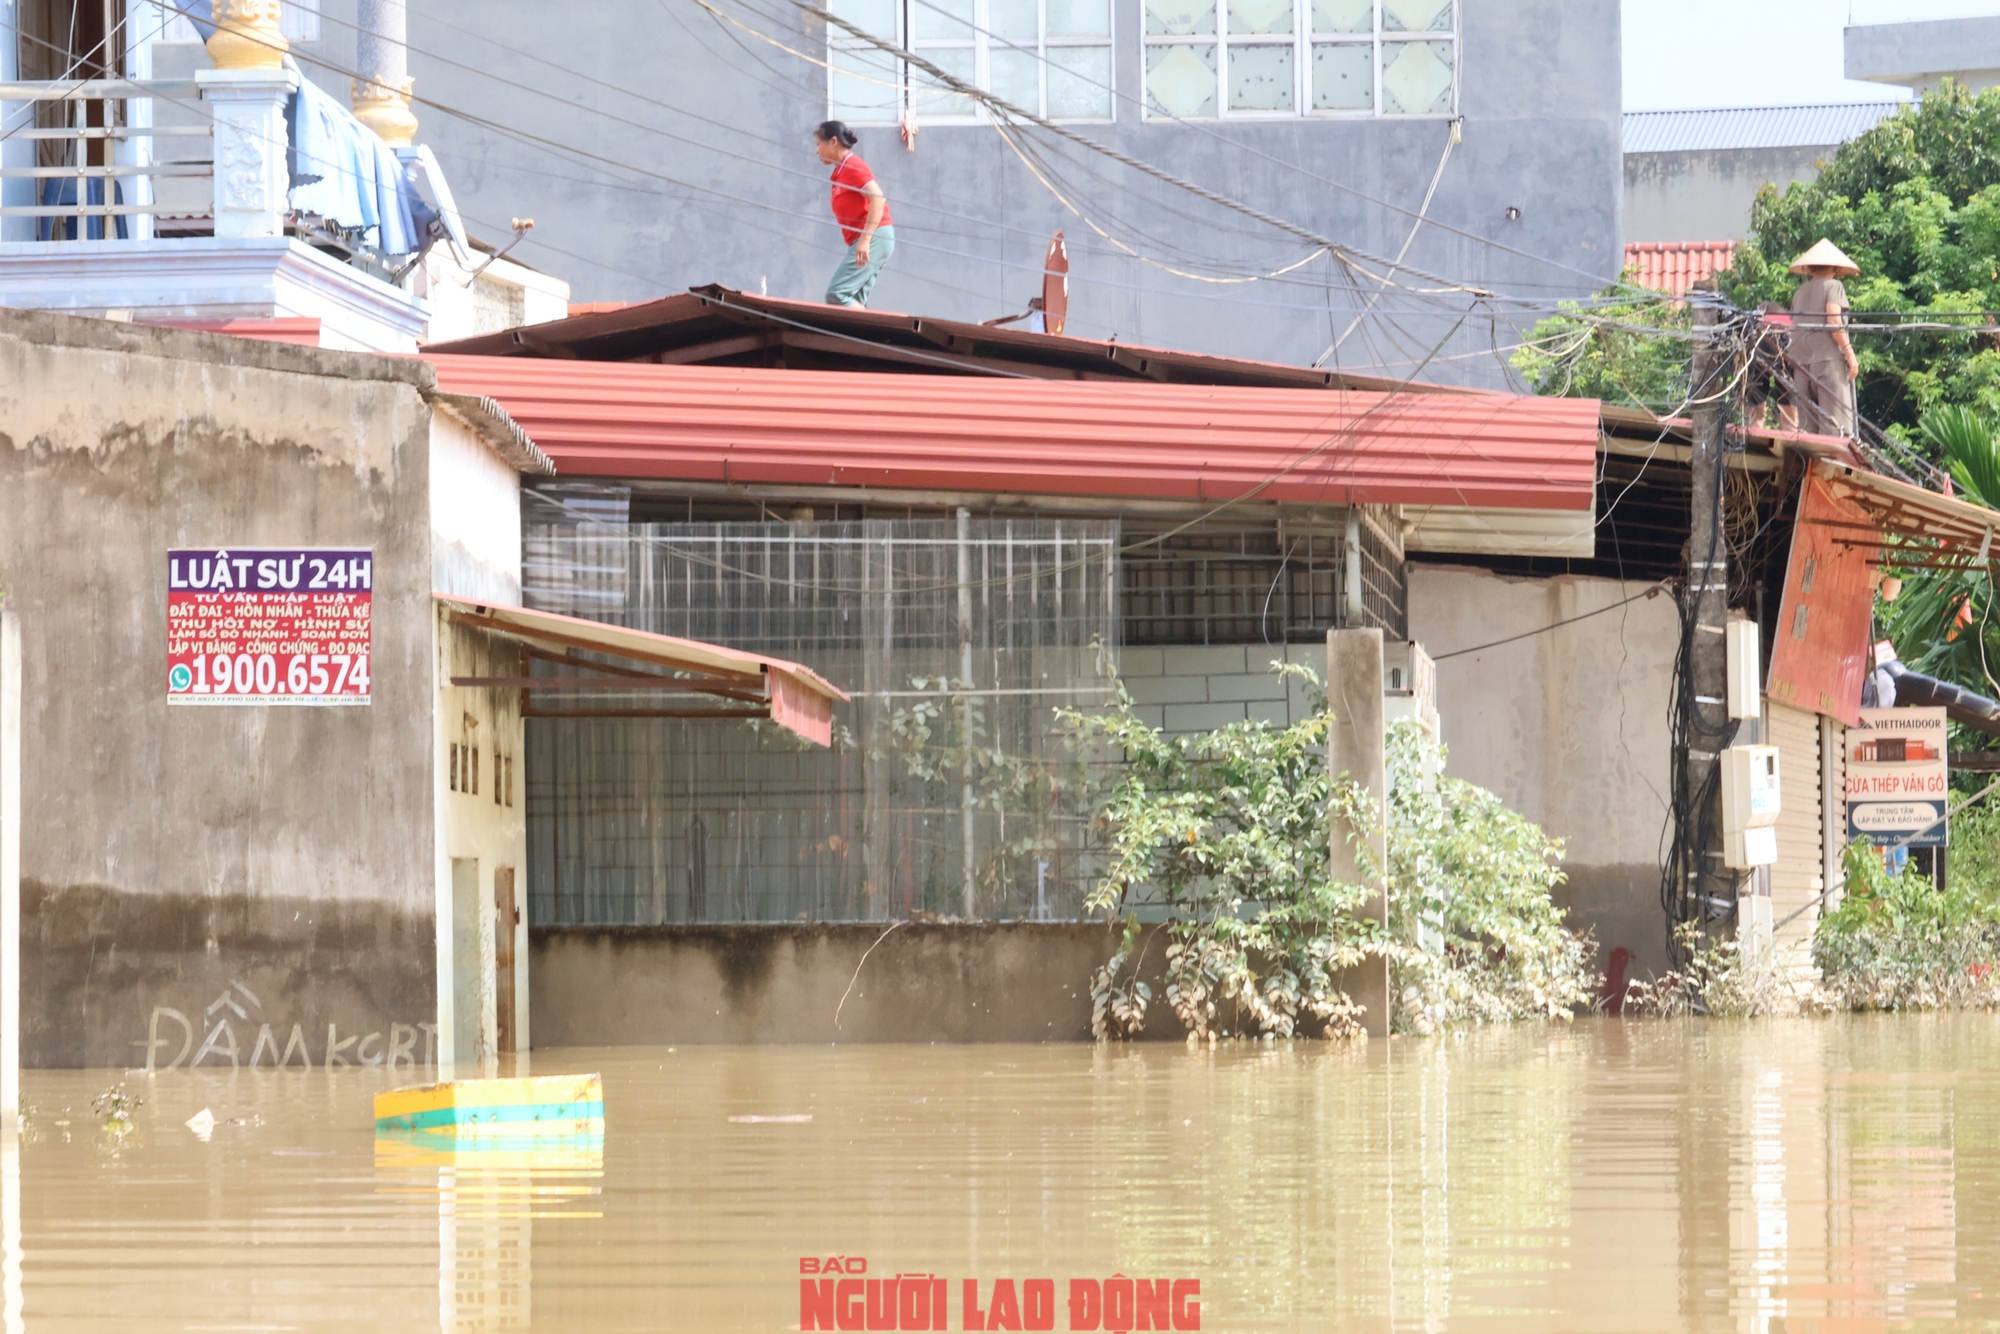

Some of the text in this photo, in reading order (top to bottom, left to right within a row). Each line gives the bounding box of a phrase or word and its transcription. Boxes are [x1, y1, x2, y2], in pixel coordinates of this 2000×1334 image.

[170, 550, 371, 593] LUẬT SƯ 24H
[194, 591, 357, 606] TƯ VẤN PHÁP LUẬT
[169, 601, 196, 618] ĐẤT
[198, 604, 223, 618] ĐAI
[234, 602, 263, 618] HÔN
[266, 602, 303, 618] NHÂN
[353, 602, 371, 618] KẾ
[170, 619, 207, 629] THU
[211, 616, 245, 629] HỒI
[250, 618, 278, 631] NỢ
[294, 617, 341, 630] HÌNH
[345, 618, 371, 631] SỰ
[169, 628, 196, 639] LÀM
[242, 629, 289, 639] NHANH
[300, 630, 336, 641] SOẠN
[339, 630, 369, 639] ĐƠN
[168, 638, 189, 657] LẬP
[191, 641, 204, 654] VI
[206, 638, 237, 655] BẰNG
[246, 638, 277, 655] CÔNG
[279, 638, 319, 655] CHỨNG
[328, 641, 345, 655] ĐO
[347, 641, 370, 657] ĐẠC
[192, 653, 370, 694] 1900.6574
[1874, 718, 1941, 730] VIETTHAIDOOR
[1872, 773, 1900, 793] THÉP
[1902, 772, 1925, 793] VÂN
[1927, 772, 1944, 792] GỖ
[1875, 806, 1914, 815] TRUNG TÂM
